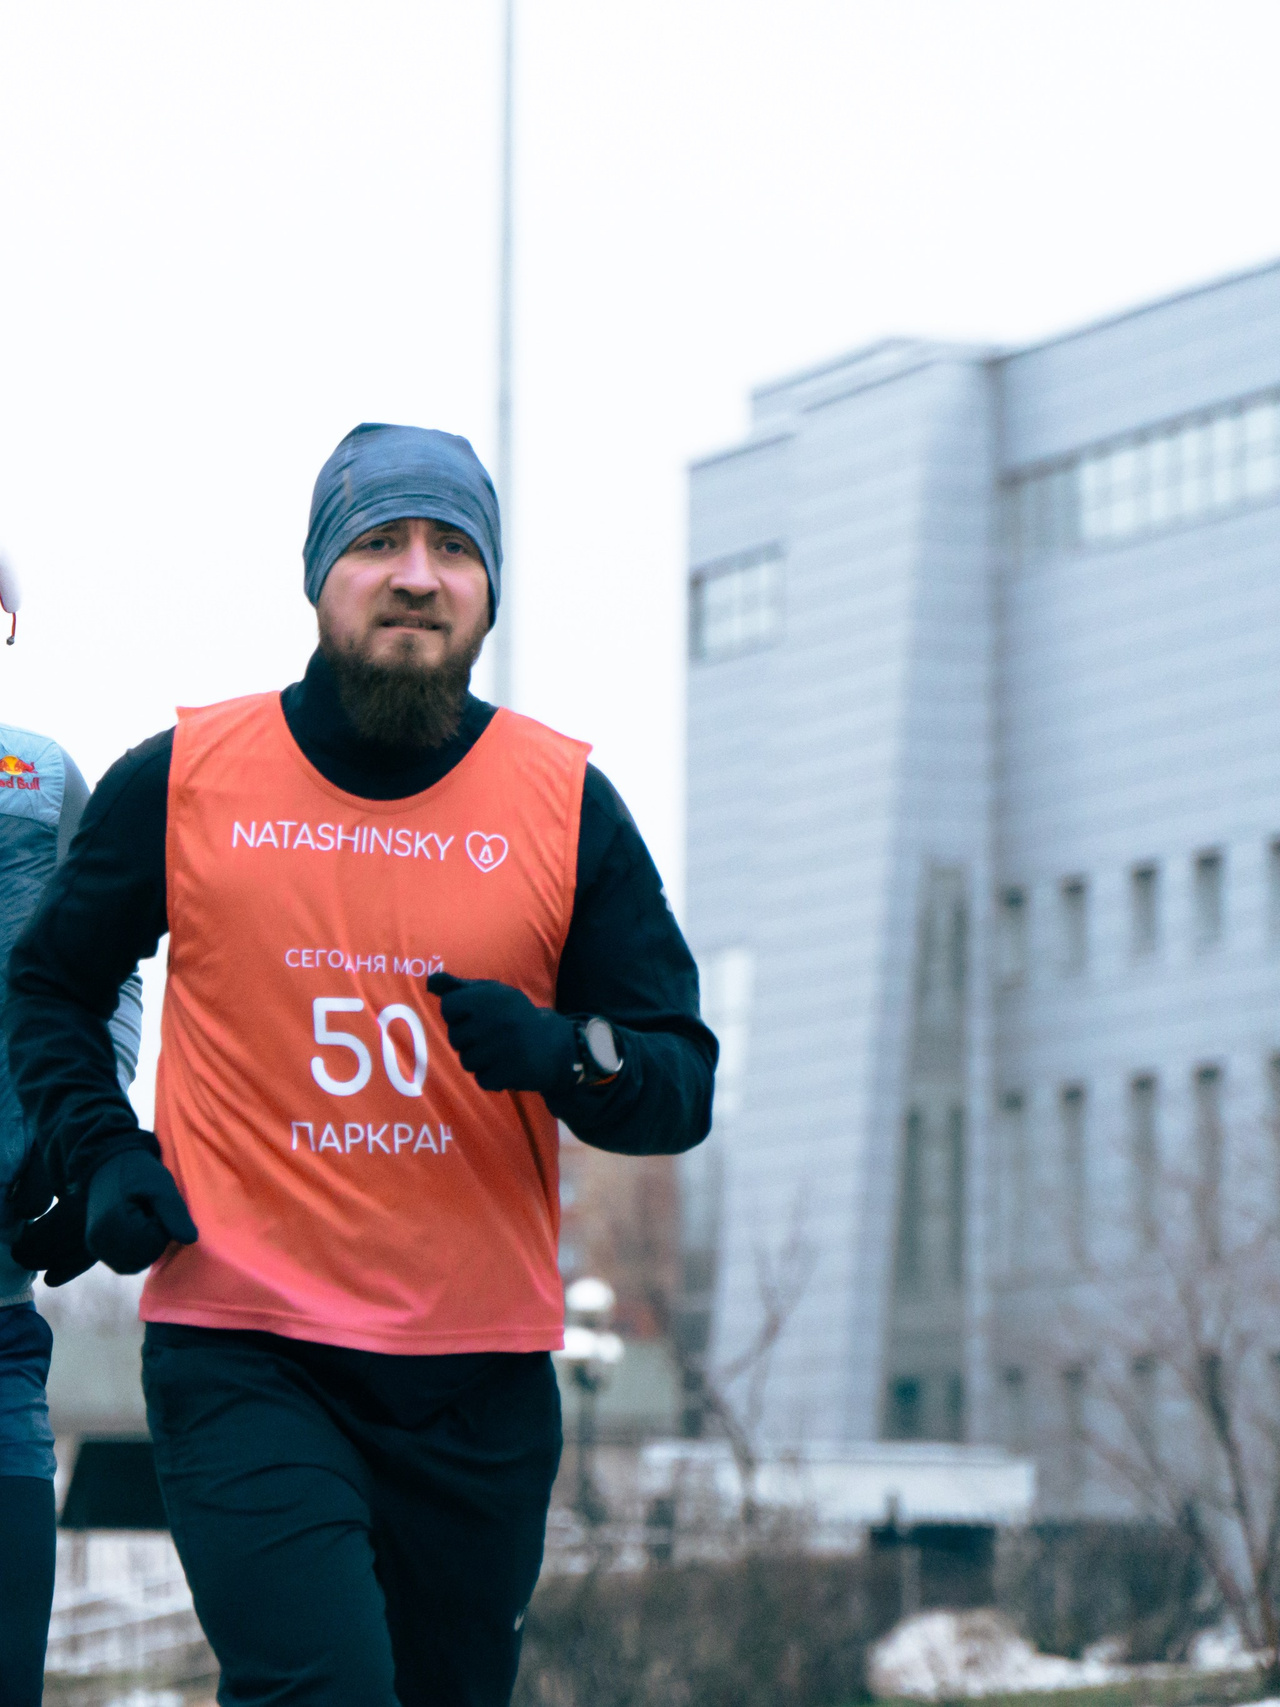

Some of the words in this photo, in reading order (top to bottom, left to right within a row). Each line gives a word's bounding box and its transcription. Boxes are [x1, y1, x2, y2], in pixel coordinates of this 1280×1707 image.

[17, 777, 40, 790] Bull
[231, 821, 454, 861] NATASHINSKY
[285, 948, 387, 975] СЕГОДНЯ
[393, 954, 444, 978] МОЙ
[310, 997, 428, 1097] 50
